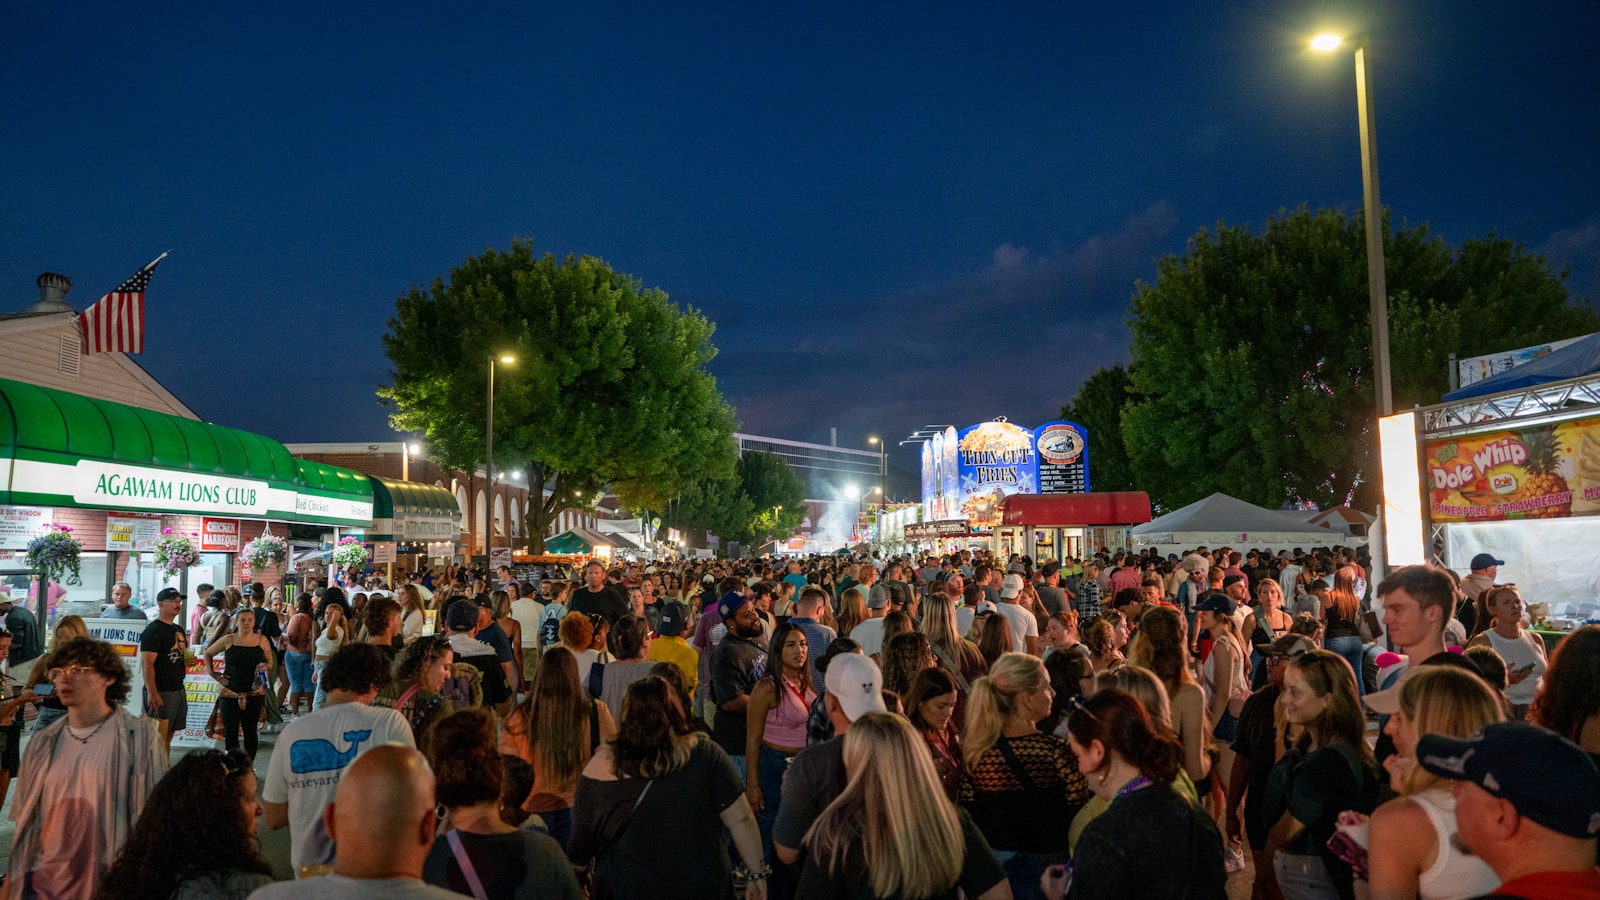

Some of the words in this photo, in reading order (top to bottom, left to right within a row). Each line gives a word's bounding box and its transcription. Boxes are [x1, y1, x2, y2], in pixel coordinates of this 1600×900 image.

[962, 448, 1029, 465] THIN-CUT
[1432, 465, 1474, 489] Dole
[1473, 439, 1526, 474] Whip
[976, 466, 1019, 485] FRIES
[1494, 476, 1513, 488] Dole
[95, 473, 172, 500] AGAWAM
[179, 482, 220, 504] LIONS
[226, 487, 257, 506] CLUB
[308, 500, 329, 512] Chicken
[1435, 503, 1487, 516] PINEAPPLE
[1496, 490, 1571, 514] STRAWBERRY
[206, 521, 236, 533] CHICKEN
[203, 534, 238, 547] BARBEQUE
[104, 629, 125, 640] LIONS
[127, 631, 142, 643] CLU
[184, 682, 219, 692] FAMIL
[186, 693, 218, 703] MEAL
[290, 772, 340, 789] vineyard
